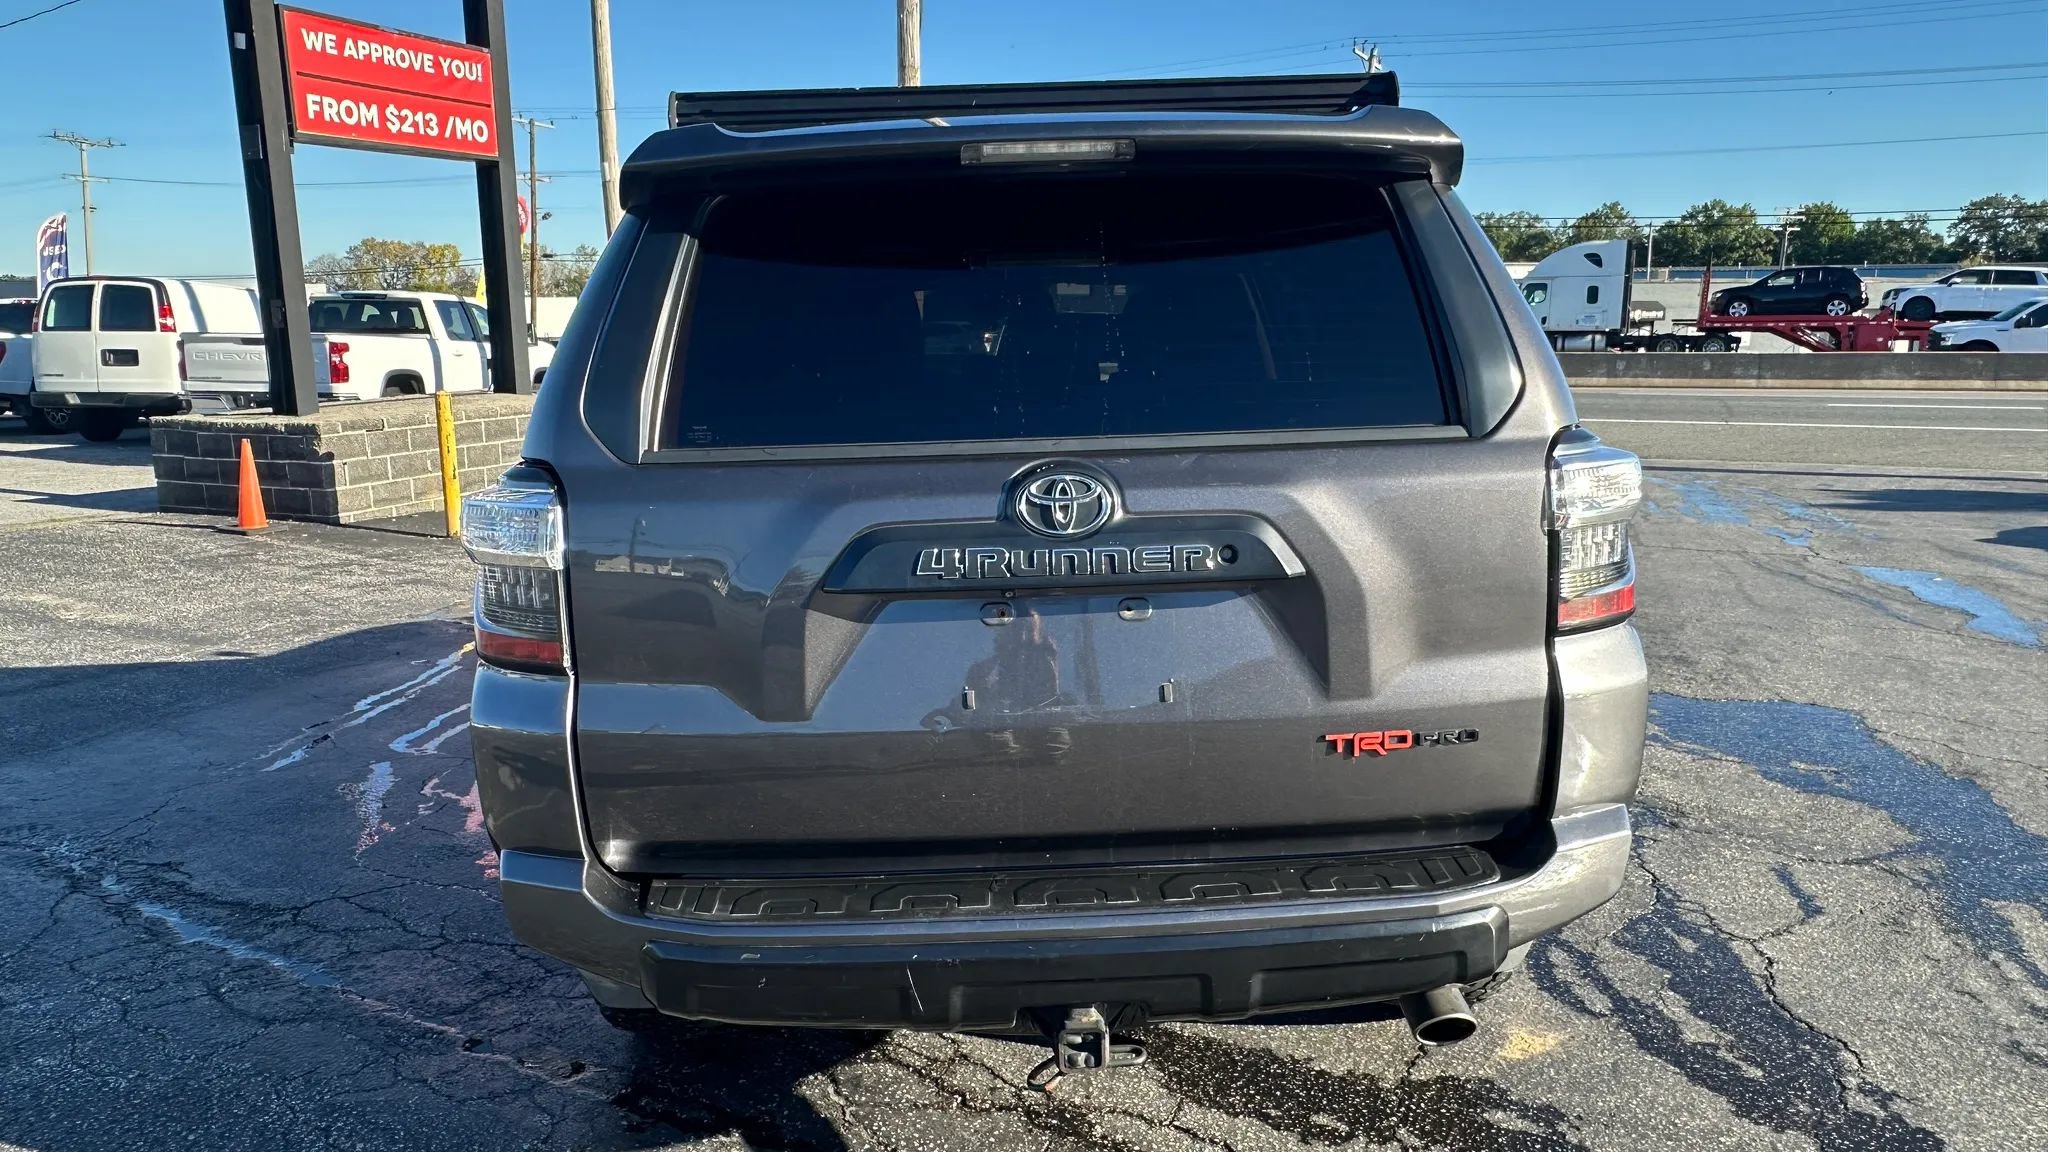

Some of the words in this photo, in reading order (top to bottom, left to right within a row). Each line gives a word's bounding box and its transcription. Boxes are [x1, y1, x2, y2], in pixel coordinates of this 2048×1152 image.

[301, 28, 339, 55] WE
[343, 38, 435, 74] APPROVE
[438, 55, 483, 82] YOU!
[306, 93, 380, 129] FROM
[385, 104, 439, 137] $213
[445, 115, 489, 143] /MO
[193, 351, 264, 361] CHEVR
[916, 544, 1214, 579] 4RUNNER
[1325, 729, 1413, 757] TRD
[1416, 728, 1479, 747] PRO
